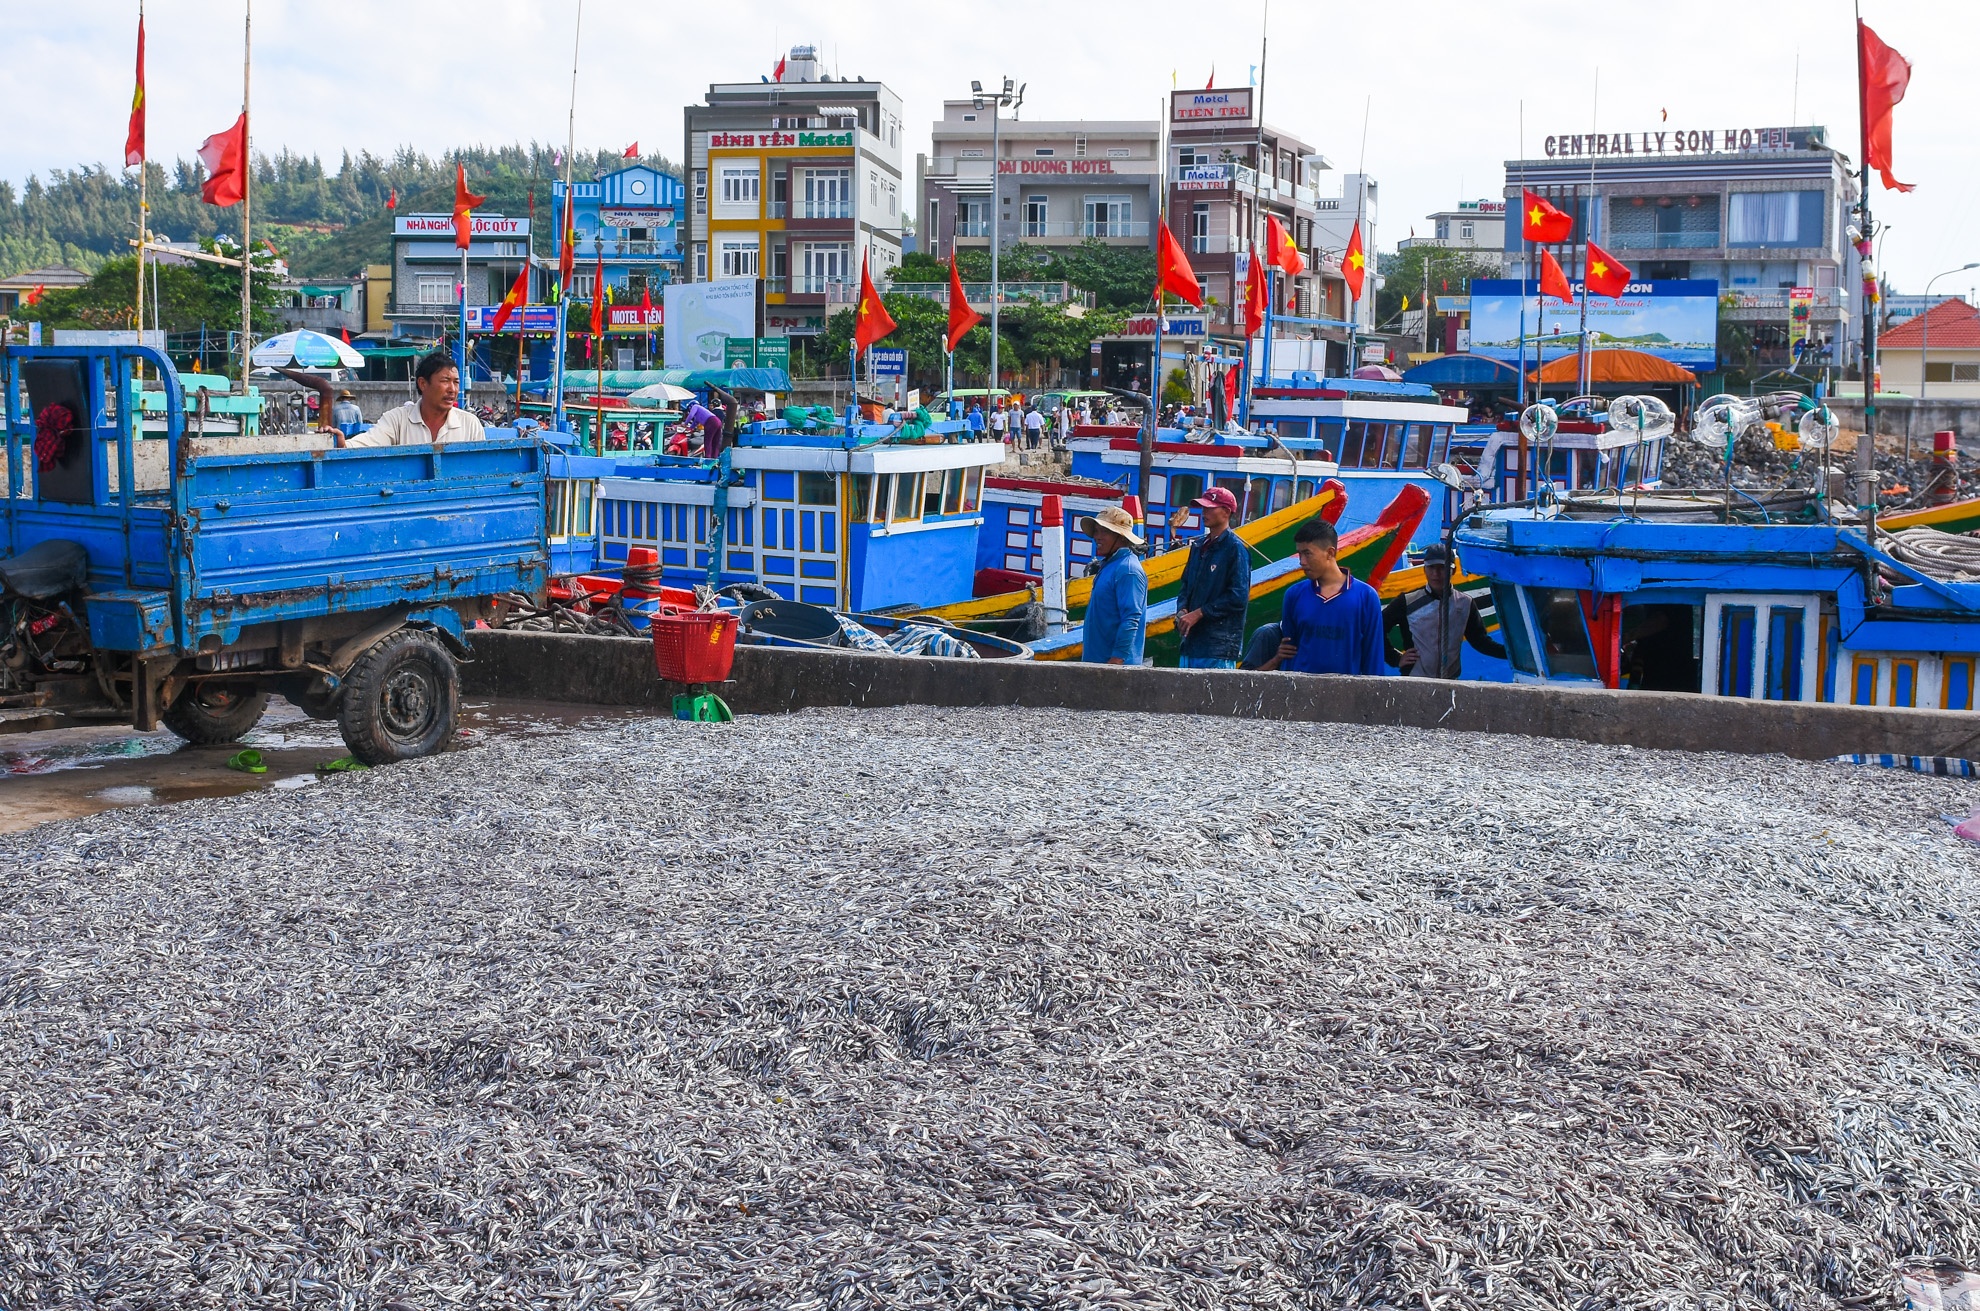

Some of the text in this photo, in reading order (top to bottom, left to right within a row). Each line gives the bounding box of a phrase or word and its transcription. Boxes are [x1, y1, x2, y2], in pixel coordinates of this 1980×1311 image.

[1194, 95, 1229, 104] Motel
[1219, 107, 1246, 116] TRI
[712, 132, 853, 147] BÌNH YÊN Motel
[1545, 128, 1792, 157] CENTRAL LY SON HOTEL
[1021, 160, 1067, 174] DUONG
[1071, 160, 1114, 174] HOTEL
[1188, 171, 1219, 180] Motel
[1207, 181, 1225, 189] TRI
[406, 218, 426, 230] NHÀ
[1755, 300, 1785, 308] COFFEE
[612, 310, 640, 324] MOTEL
[1168, 319, 1206, 336] HOTEL
